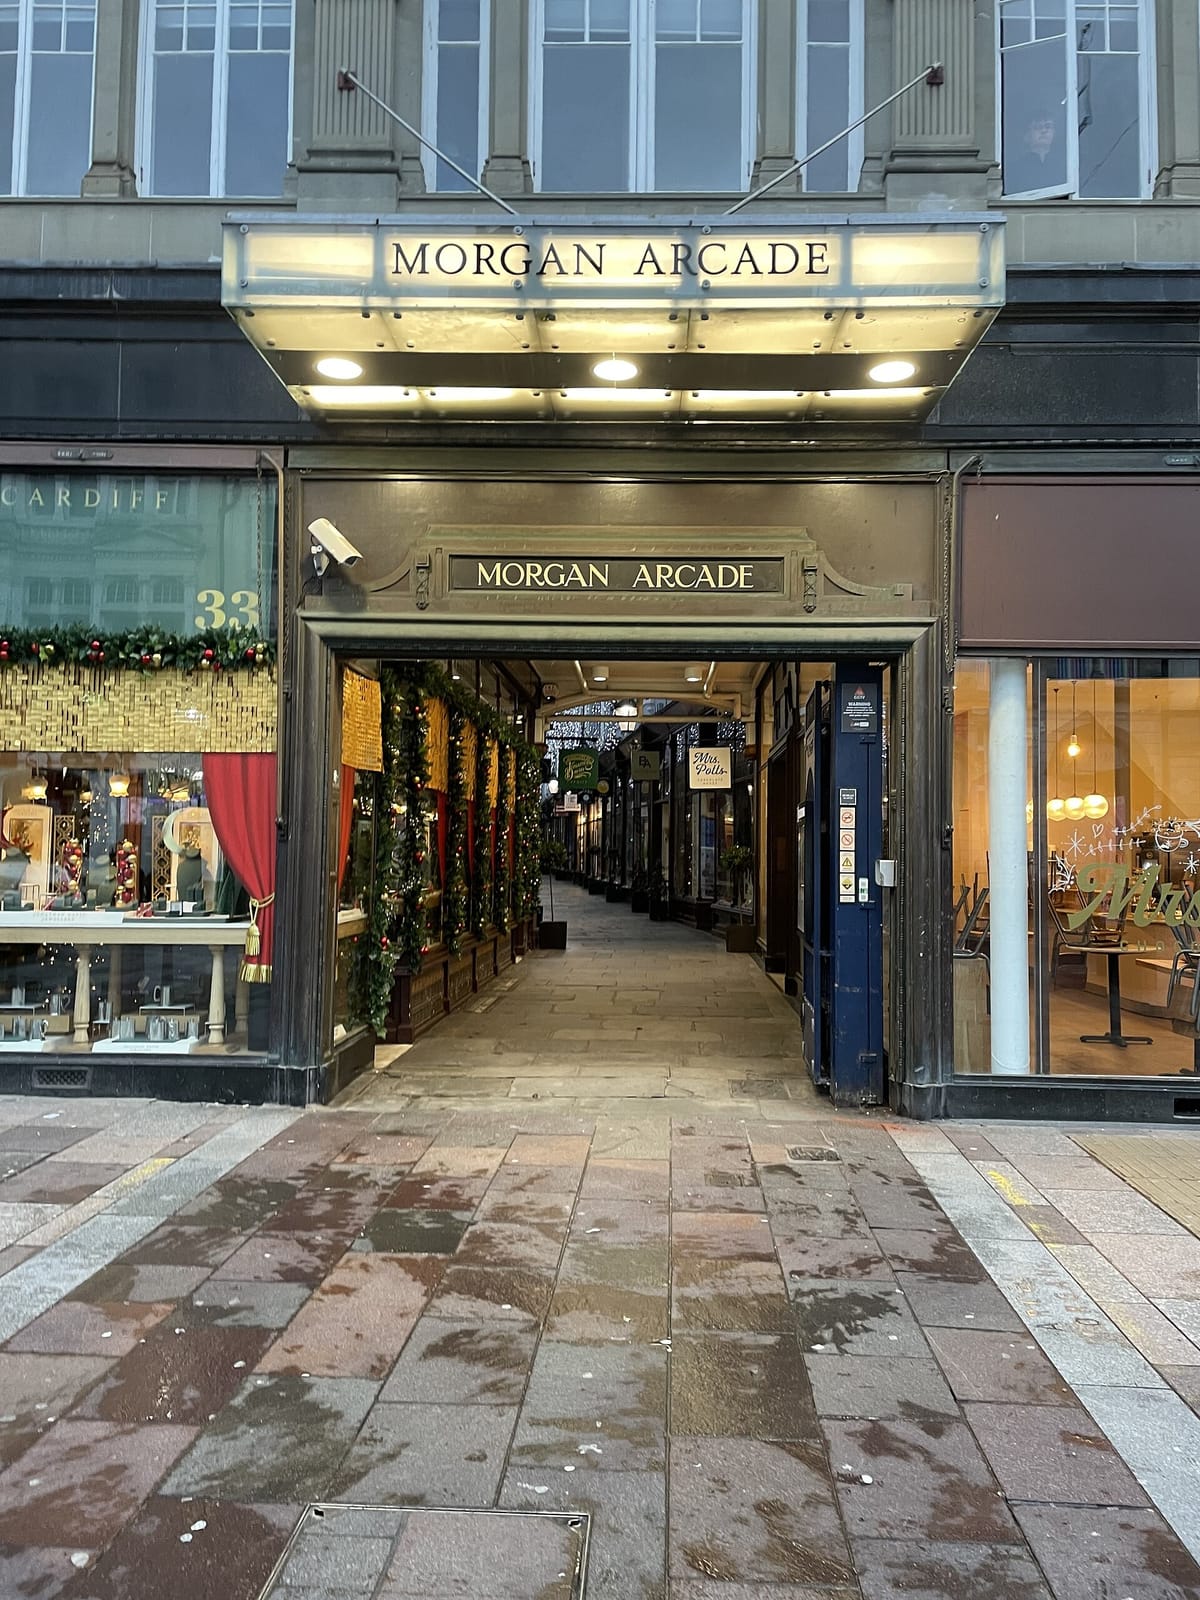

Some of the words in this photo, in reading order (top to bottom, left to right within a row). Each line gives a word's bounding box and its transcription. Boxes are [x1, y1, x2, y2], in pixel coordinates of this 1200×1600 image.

[391, 242, 606, 276] MORGAN
[633, 242, 830, 275] ARCADE
[0, 486, 170, 510] CARDIFF
[477, 562, 609, 588] MORGAN
[631, 564, 754, 589] ARCADE
[194, 589, 260, 630] 33
[692, 751, 720, 765] Mrs.
